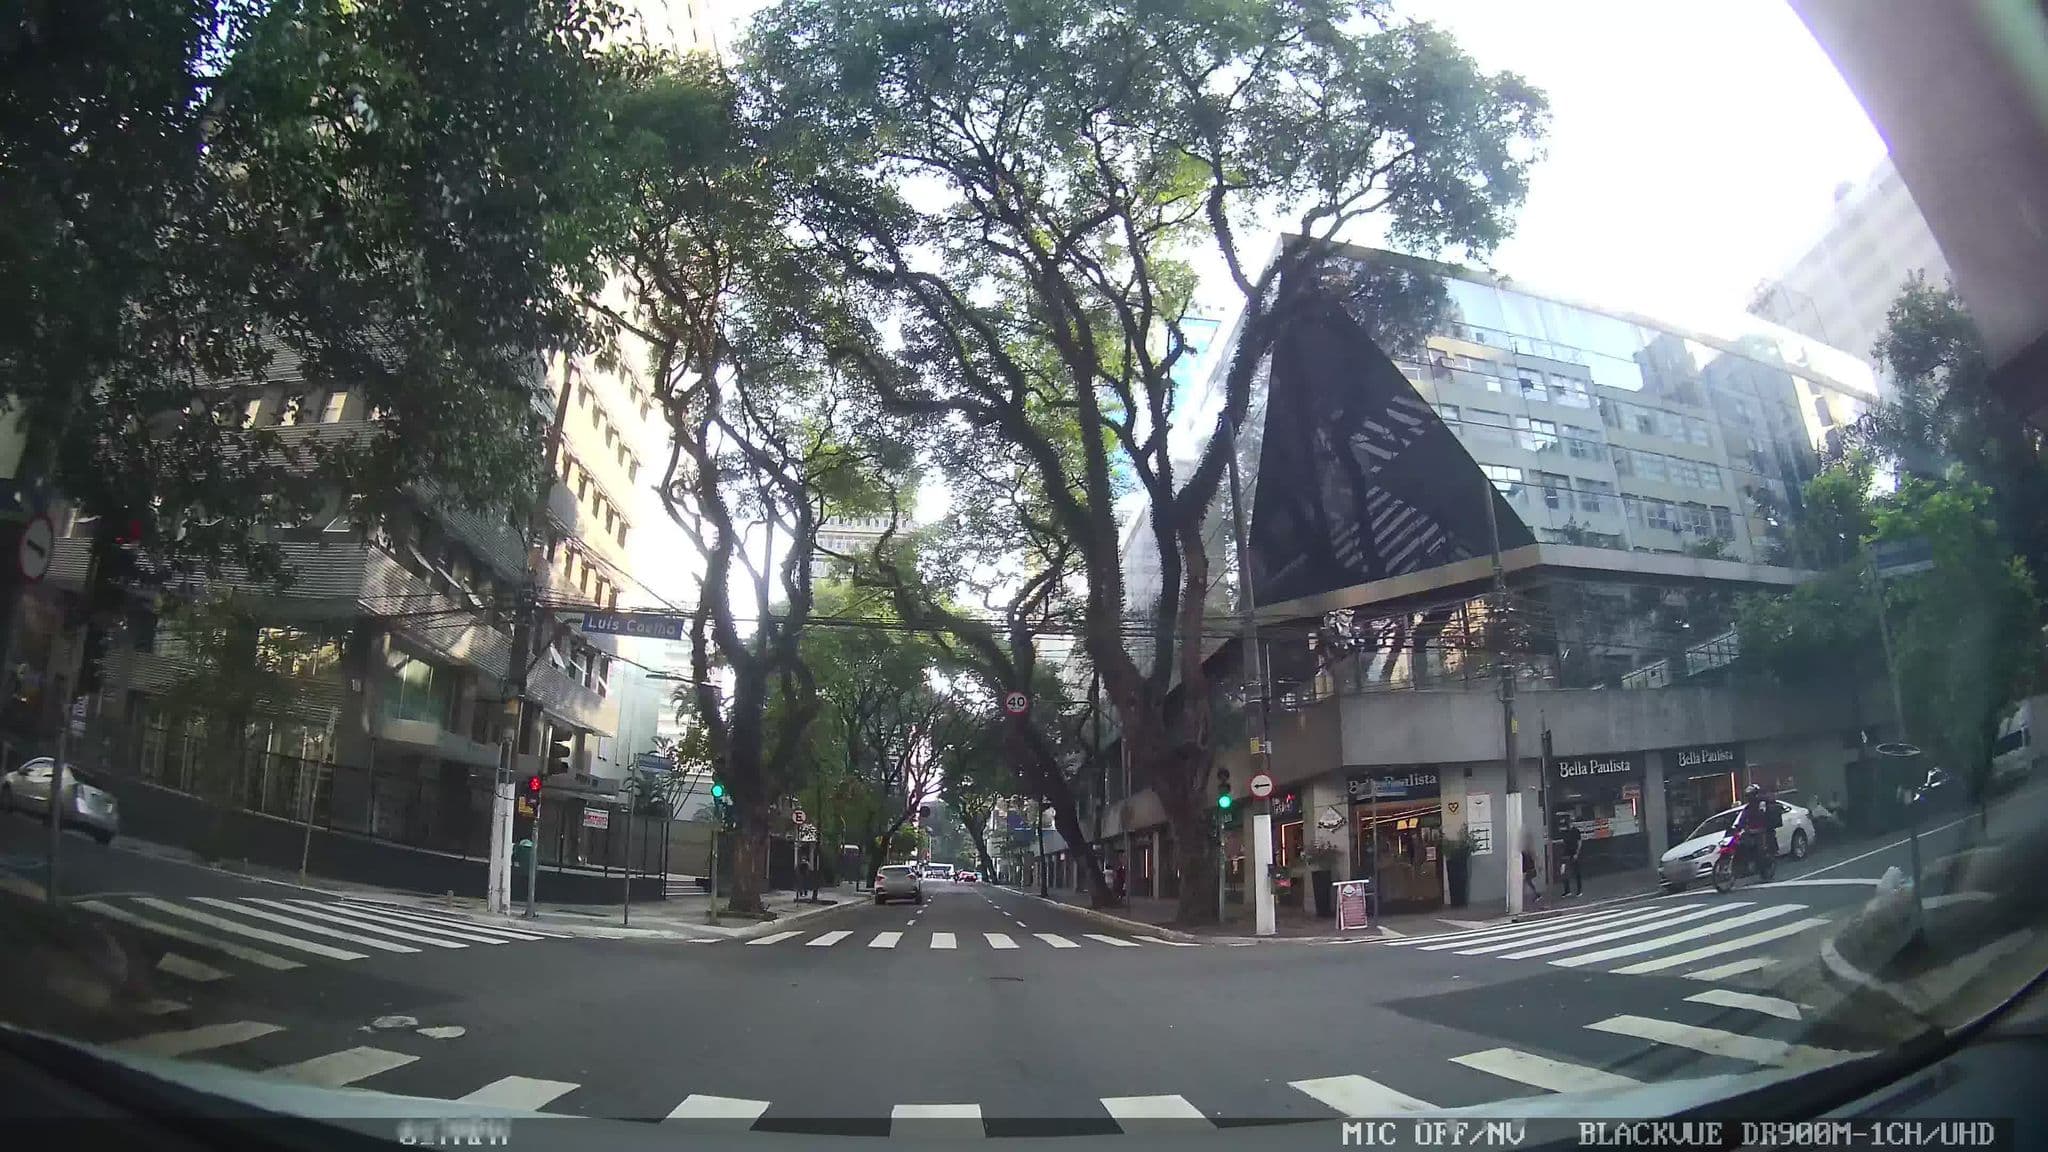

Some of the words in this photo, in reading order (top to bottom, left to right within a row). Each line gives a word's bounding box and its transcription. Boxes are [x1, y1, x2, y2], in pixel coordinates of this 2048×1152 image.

[1007, 696, 1025, 708] 40
[1678, 751, 1701, 767] Bella
[1559, 760, 1588, 778] Bella
[1589, 759, 1631, 774] Paulista
